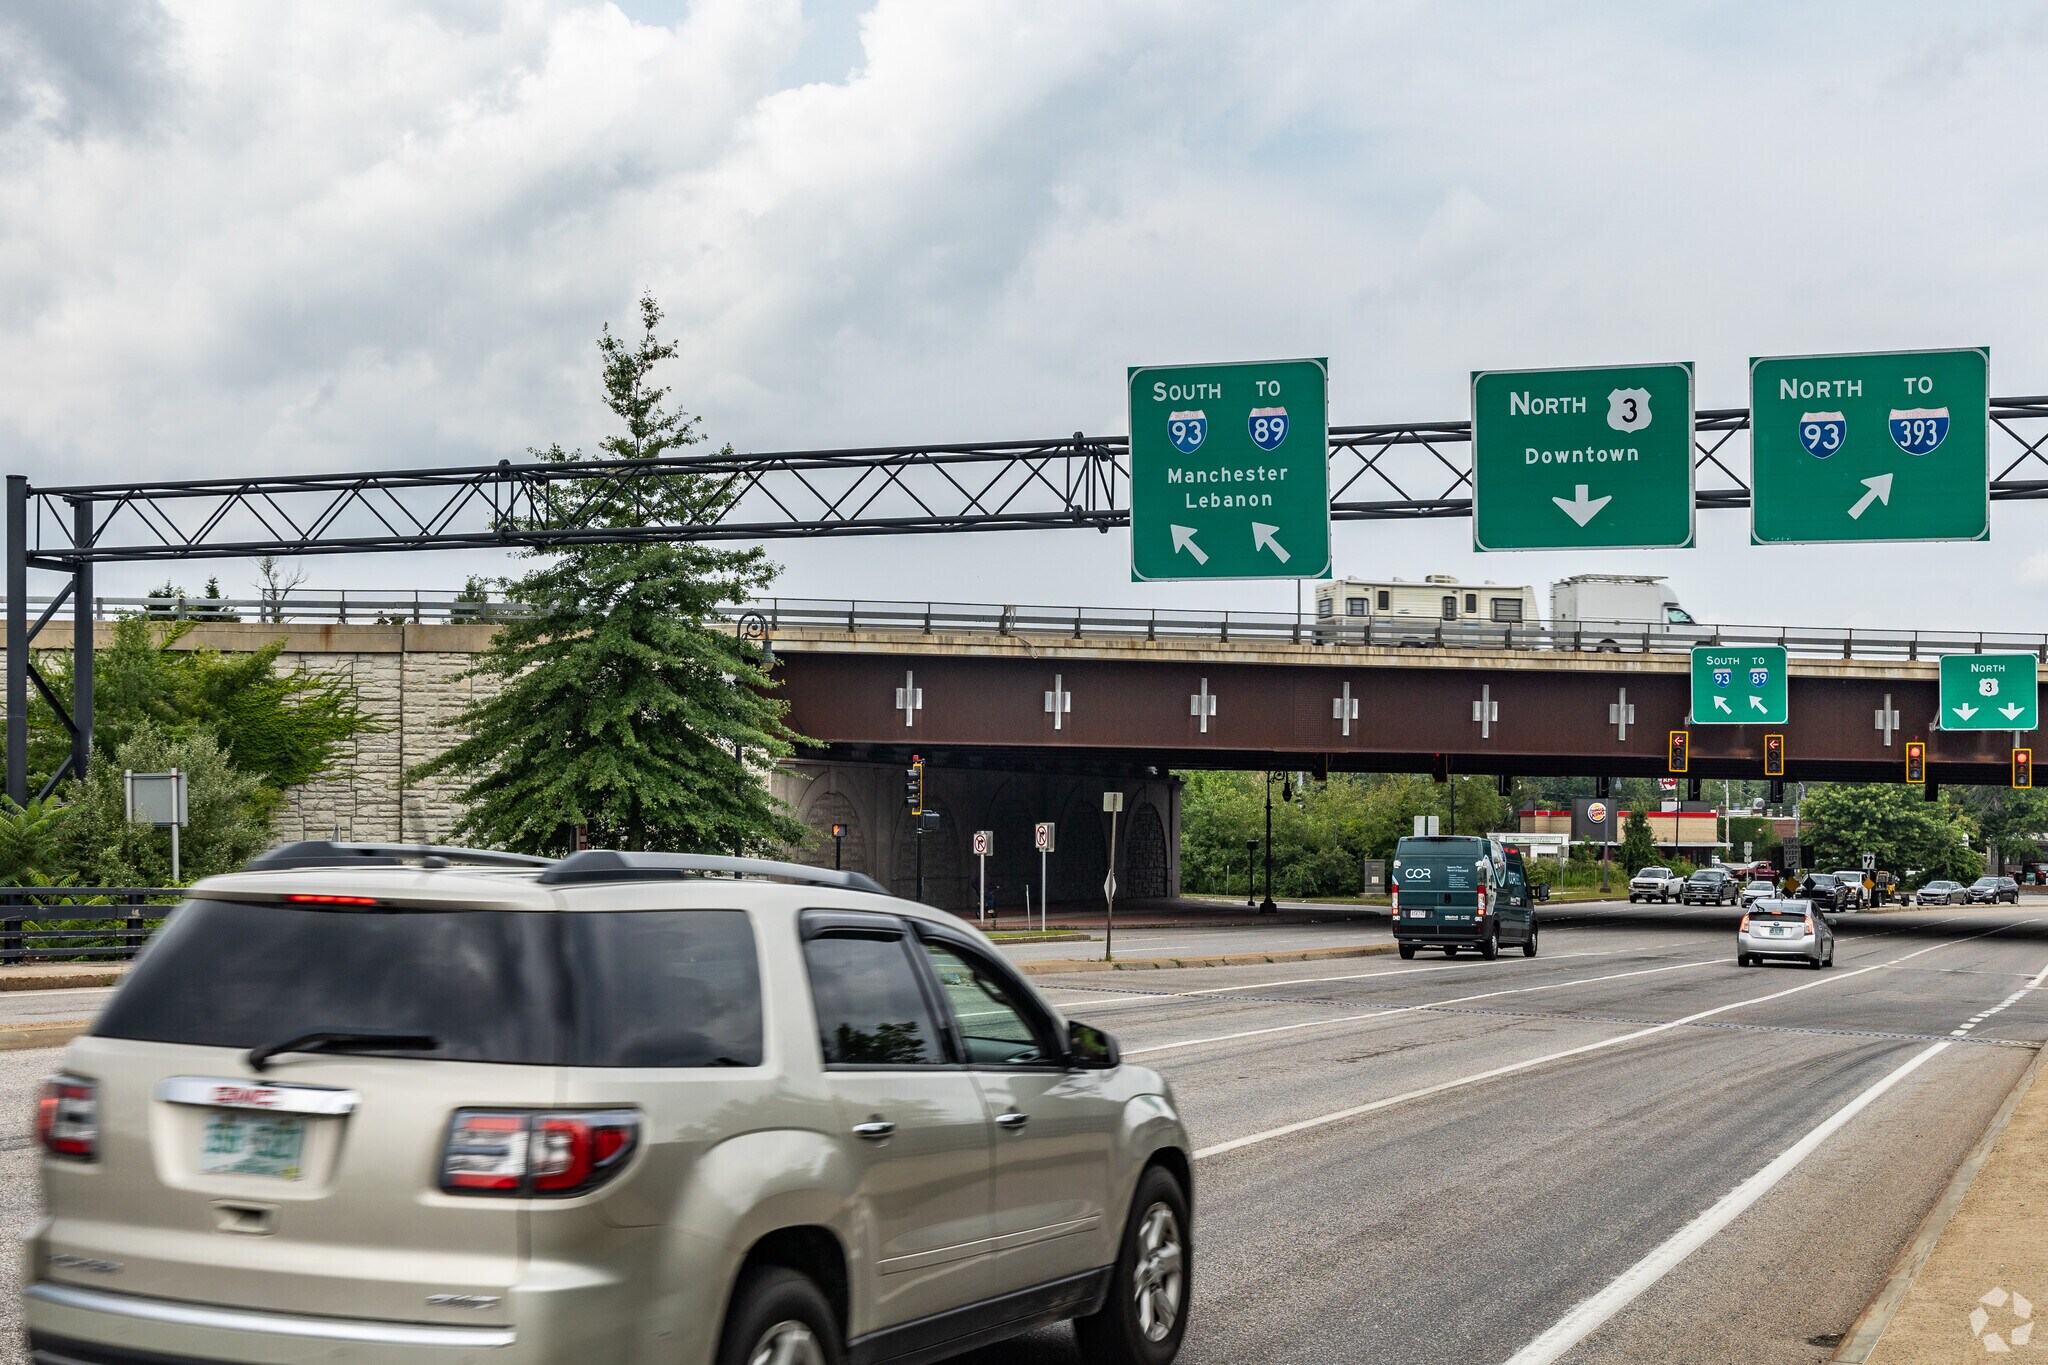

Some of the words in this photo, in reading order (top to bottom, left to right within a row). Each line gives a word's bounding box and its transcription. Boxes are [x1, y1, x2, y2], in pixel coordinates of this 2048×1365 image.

[1152, 382, 1222, 402] SOUTH
[1255, 380, 1281, 397] TO
[1779, 378, 1863, 400] NORTH
[1903, 376, 1933, 395] TO
[1510, 391, 1587, 416] NORTH
[1621, 398, 1638, 423] 3
[1172, 421, 1202, 445] 93
[1254, 417, 1285, 443] 89
[1804, 423, 1840, 450] 93
[1900, 419, 1937, 447] 393
[1525, 446, 1639, 465] Downtown
[1167, 466, 1288, 484] Manchester
[1185, 493, 1273, 509] Lebanon
[1706, 655, 1740, 665] SOUTH
[1752, 656, 1765, 665] TO
[1970, 663, 2006, 673] NORTH
[1714, 673, 1730, 684] 93
[1752, 672, 1767, 684] 89
[1985, 681, 1993, 693] 3
[1405, 868, 1431, 879] COR
